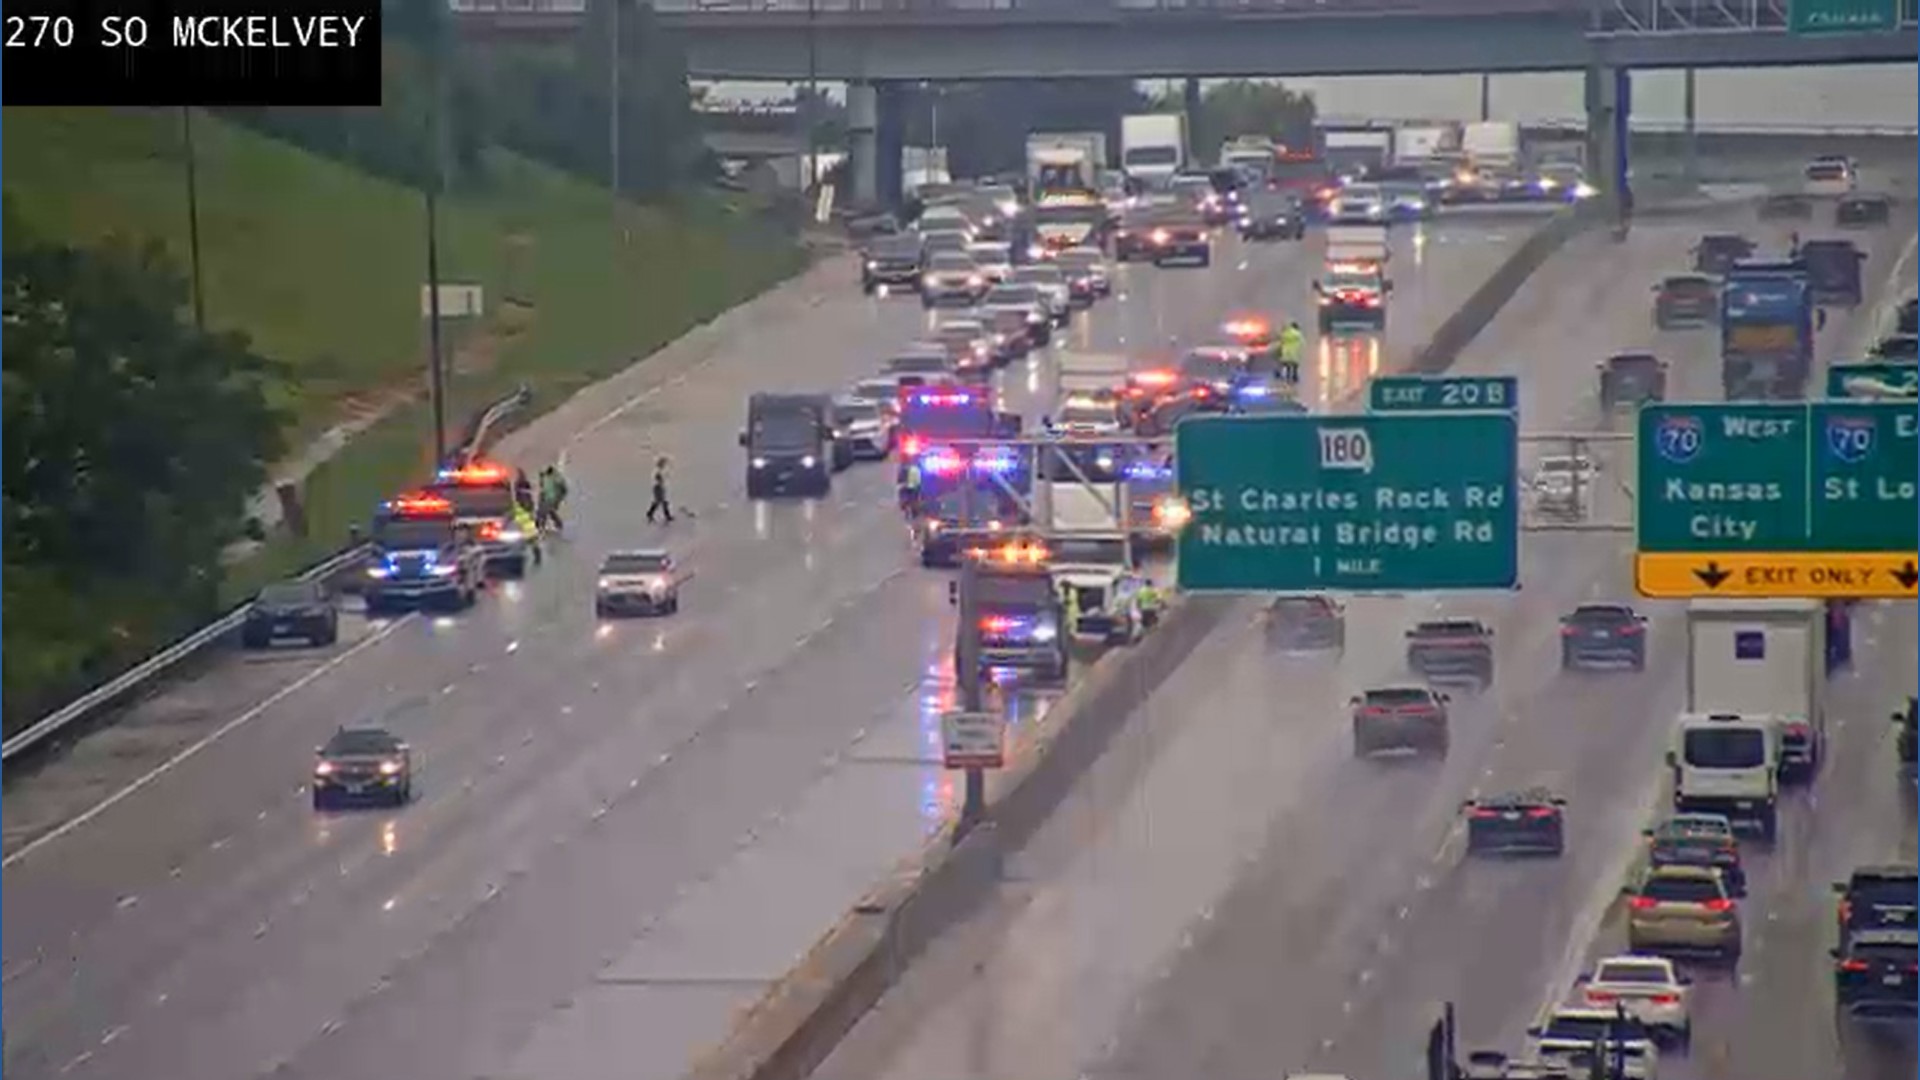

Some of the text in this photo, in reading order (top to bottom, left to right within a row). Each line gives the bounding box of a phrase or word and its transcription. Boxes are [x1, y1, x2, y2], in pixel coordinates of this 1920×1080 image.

[1442, 384, 1478, 404] 20
[1722, 415, 1793, 438] WEST
[1324, 435, 1366, 463] 180
[1665, 431, 1698, 453] 70
[1836, 430, 1870, 452] 70
[1192, 486, 1505, 511] St Charles Rock Rd
[1665, 478, 1782, 501] Kansas
[1825, 477, 1859, 500] St
[1202, 520, 1493, 549] Natural Bridge Rd
[1690, 515, 1757, 540] City
[1314, 557, 1321, 576] 1
[1745, 567, 1875, 585] EXIT ONLY
